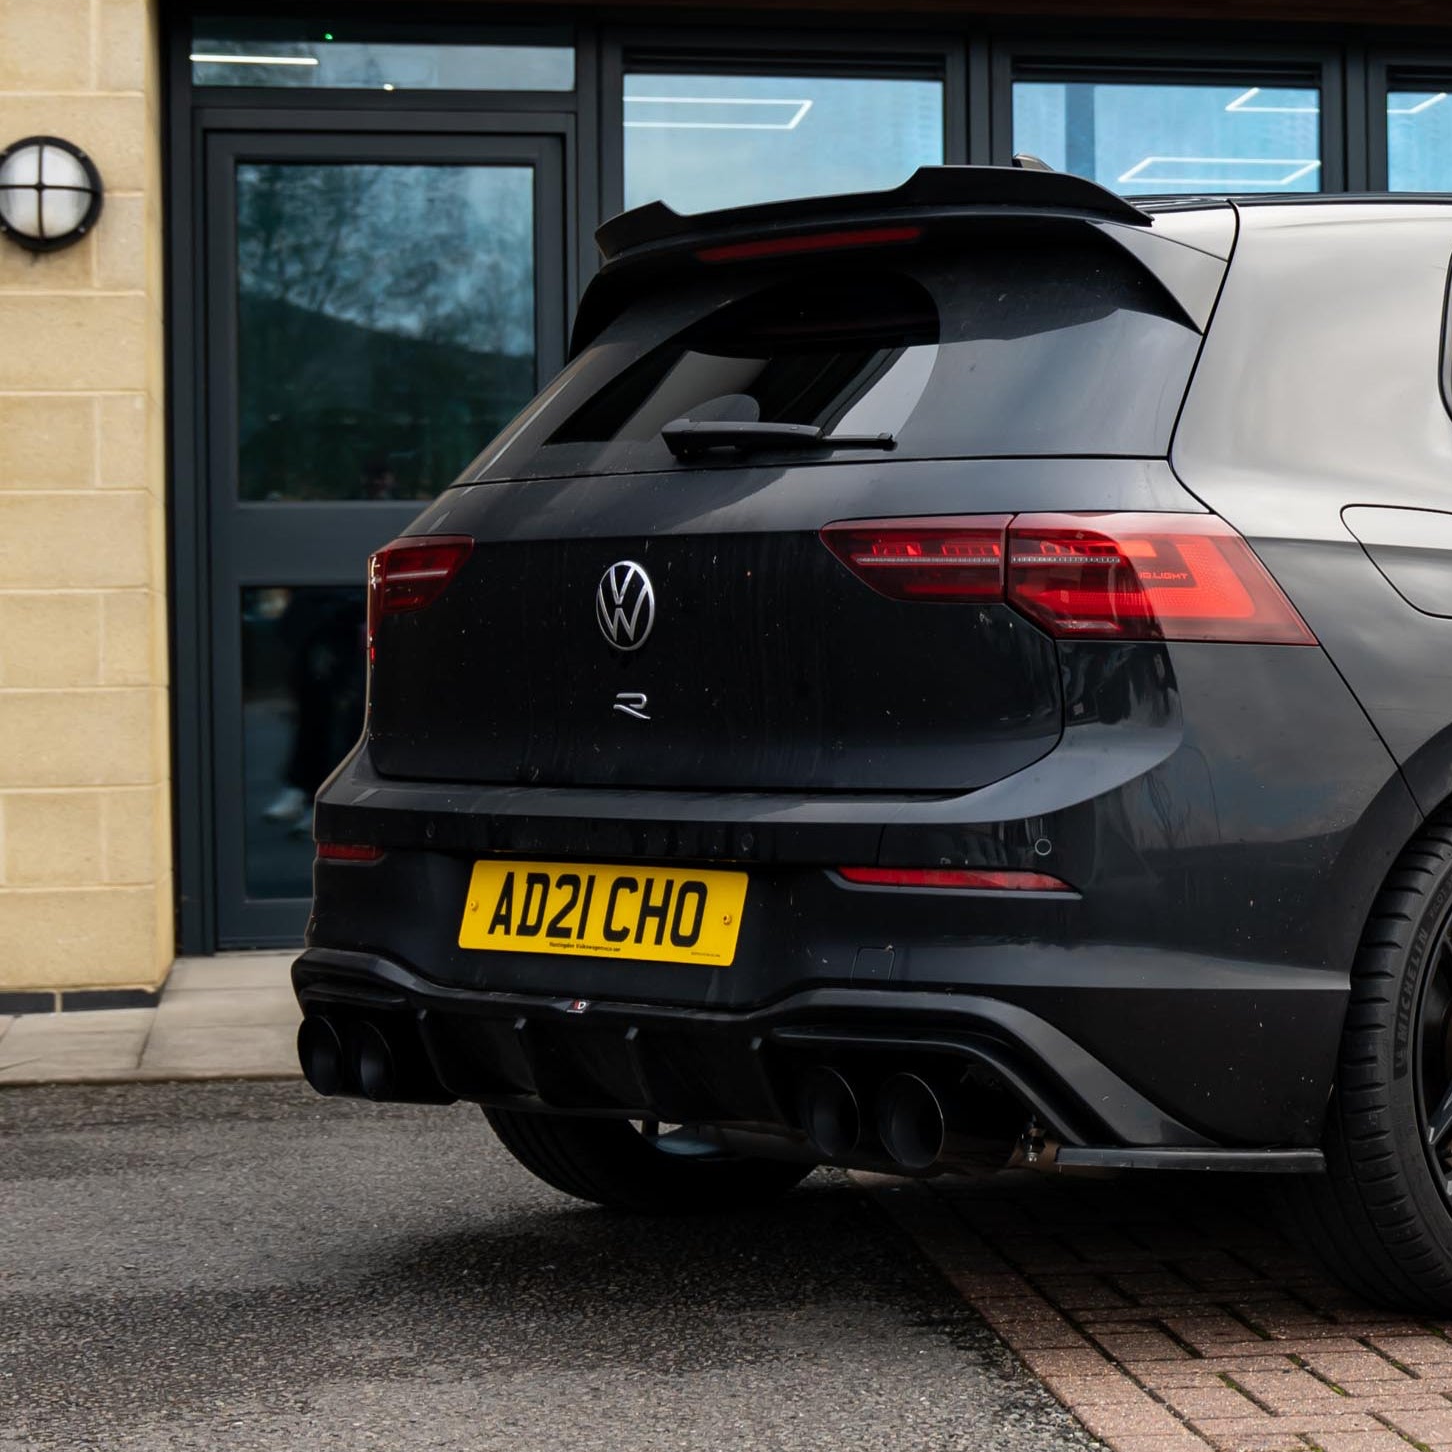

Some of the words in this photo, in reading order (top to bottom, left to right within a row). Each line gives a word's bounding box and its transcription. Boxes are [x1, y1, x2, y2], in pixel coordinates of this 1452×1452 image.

[613, 693, 651, 720] R
[487, 871, 596, 940] AD21
[603, 876, 708, 948] CHO
[1397, 926, 1429, 1037] MICHELIN
